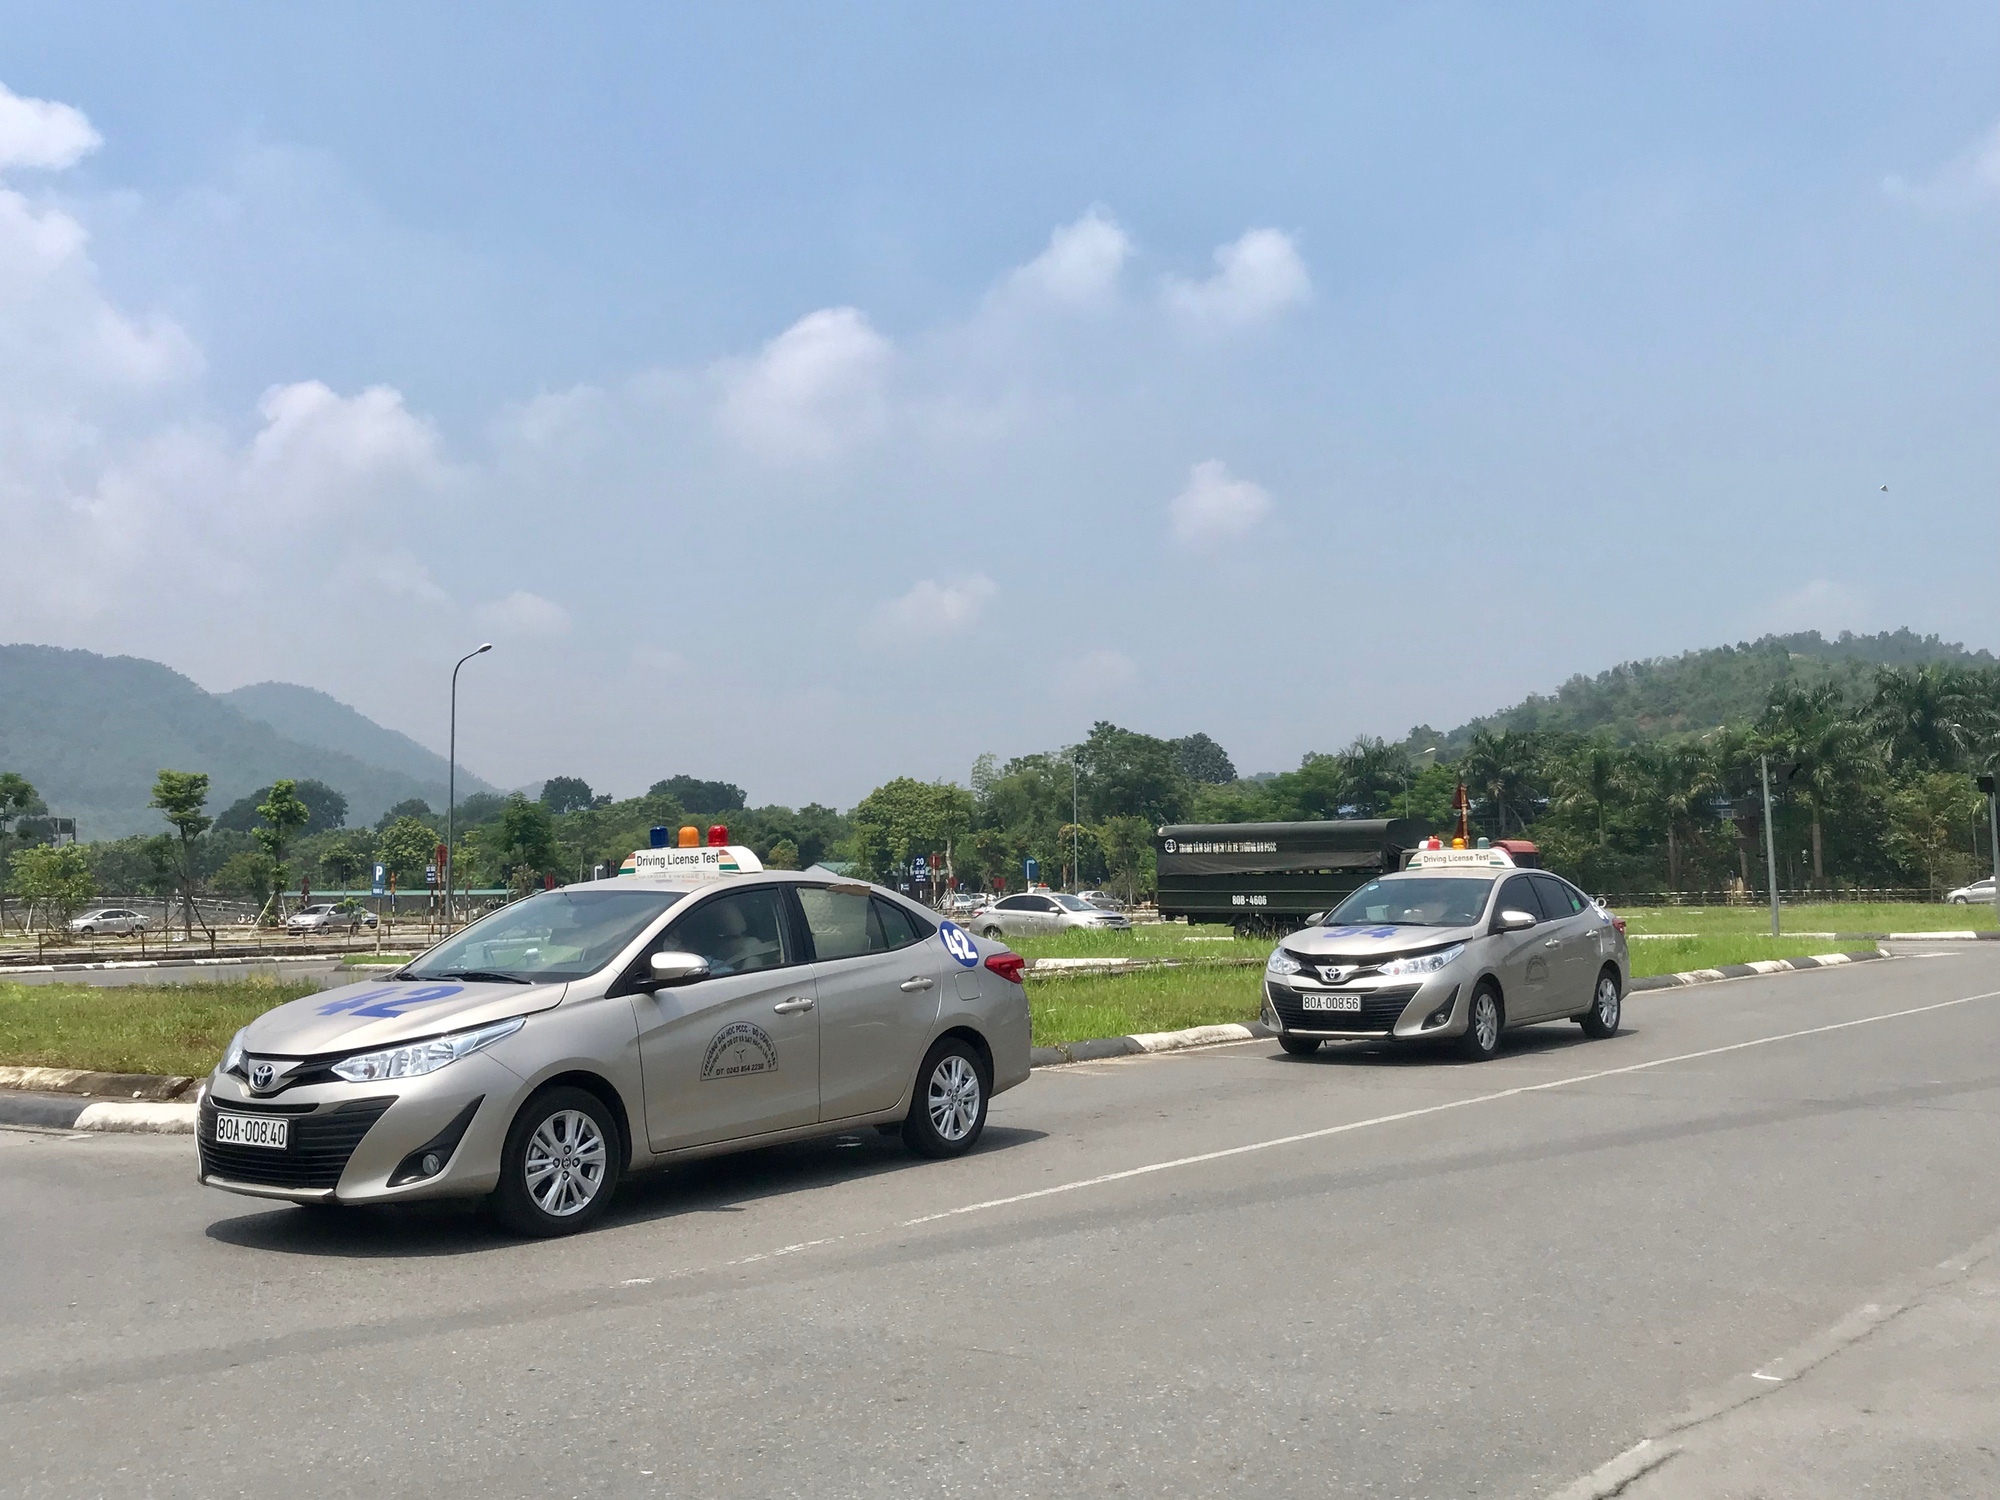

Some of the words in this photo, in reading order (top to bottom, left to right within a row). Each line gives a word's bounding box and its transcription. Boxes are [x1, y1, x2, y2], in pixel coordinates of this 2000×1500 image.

[636, 854, 666, 869] Driving
[667, 853, 700, 865] License
[701, 852, 719, 864] Test
[915, 857, 925, 866] 20
[1423, 855, 1447, 864] Driving
[1448, 854, 1474, 862] License
[1475, 853, 1490, 861] Test
[375, 865, 383, 881] P
[941, 928, 978, 960] 42
[312, 985, 465, 1018] 42
[736, 1025, 748, 1034] PCCC
[217, 1117, 286, 1146] 80A-008.40
